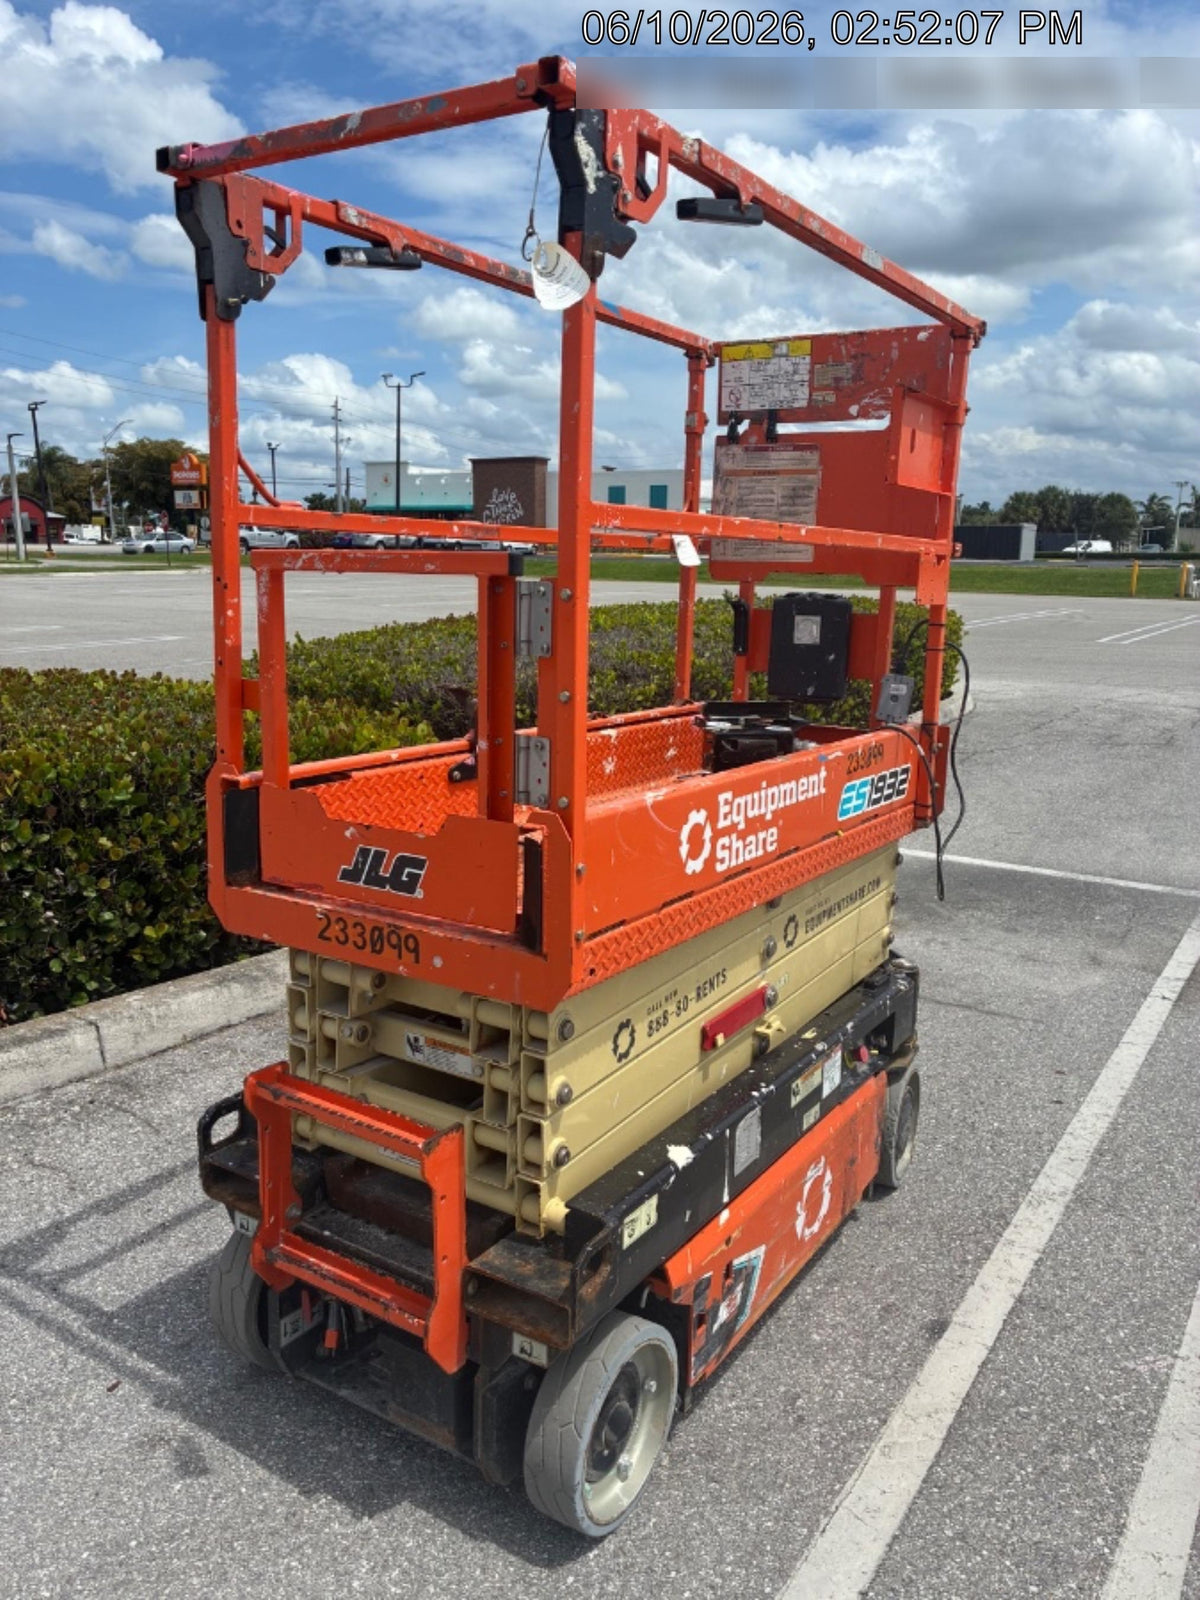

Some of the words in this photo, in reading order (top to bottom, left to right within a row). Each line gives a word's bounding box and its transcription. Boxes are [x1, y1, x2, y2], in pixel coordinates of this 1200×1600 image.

[717, 766, 828, 830] Equipment
[838, 763, 912, 821] ES1932
[337, 844, 428, 898] JLG
[715, 826, 779, 873] Share
[317, 911, 420, 964] 233099
